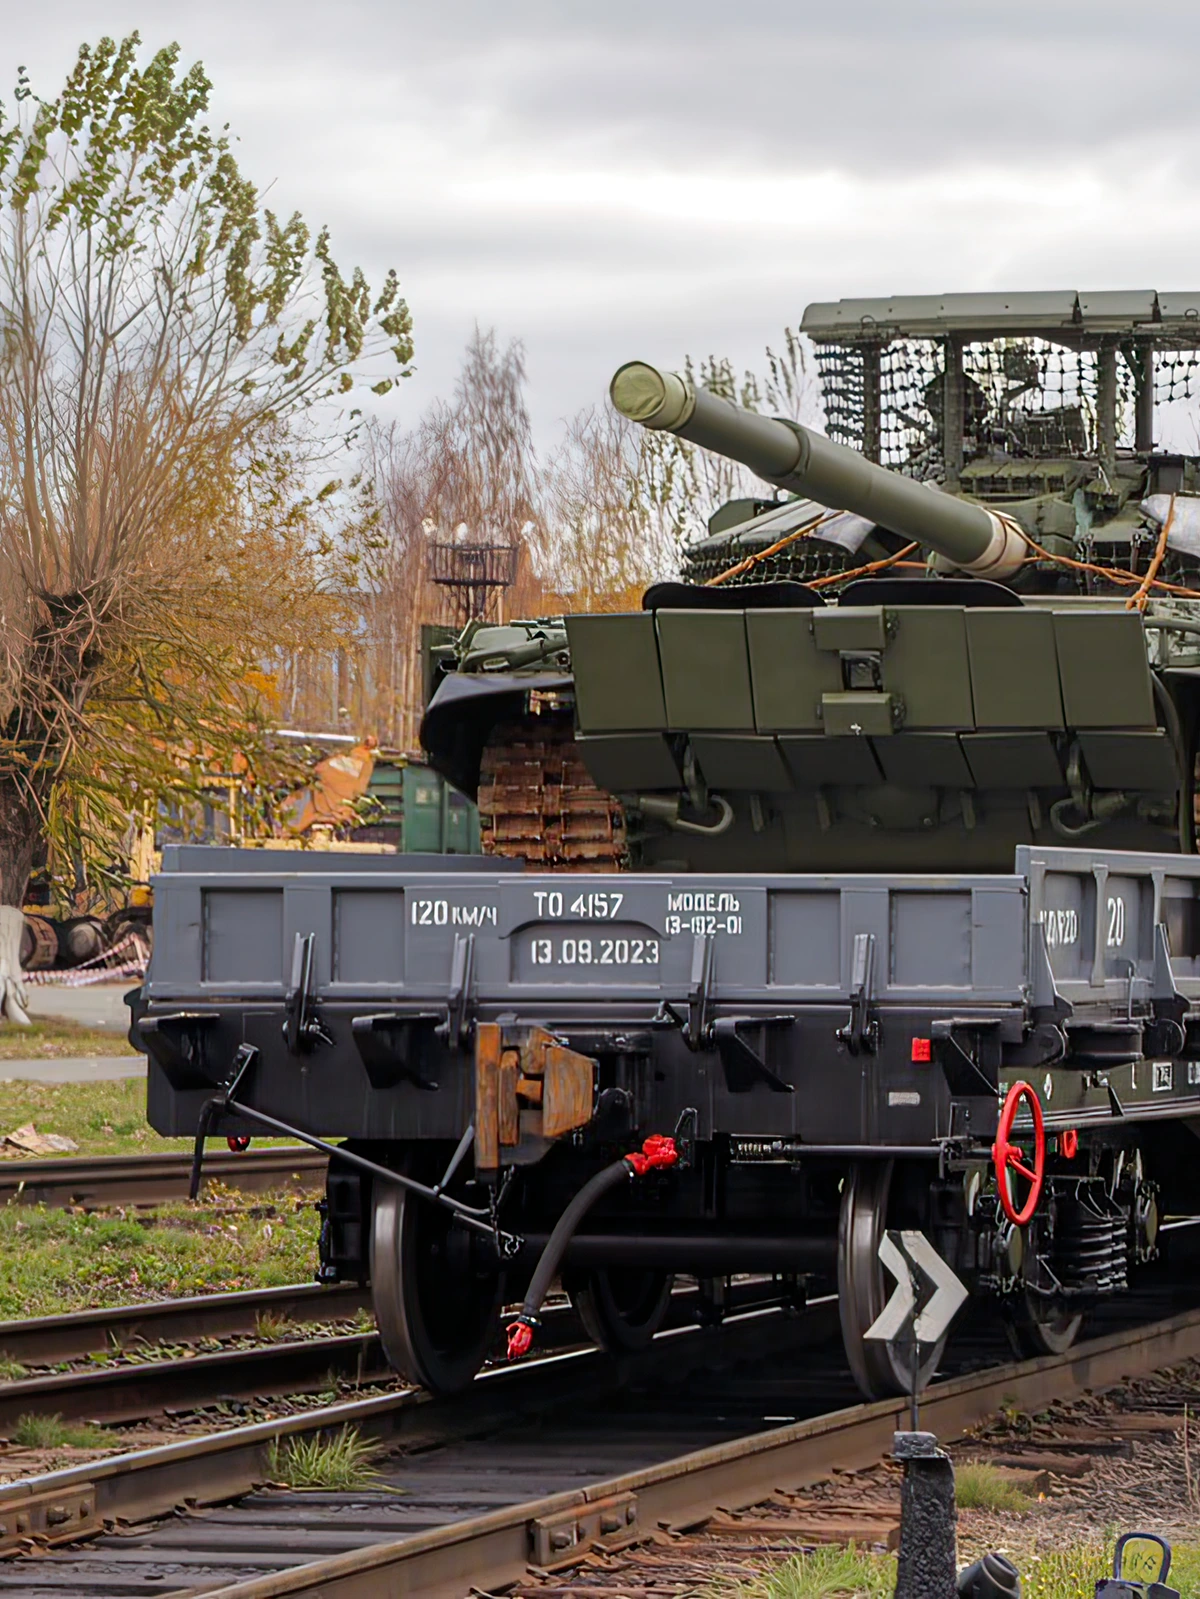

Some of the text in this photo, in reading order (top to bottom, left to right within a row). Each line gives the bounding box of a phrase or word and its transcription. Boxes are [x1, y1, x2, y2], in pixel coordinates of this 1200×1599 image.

[411, 900, 448, 925] 120
[533, 891, 624, 918] ТО 4157
[667, 893, 740, 912] МОДЕЛЬ
[1107, 897, 1124, 946] 20
[531, 939, 660, 964] 13.09.2023
